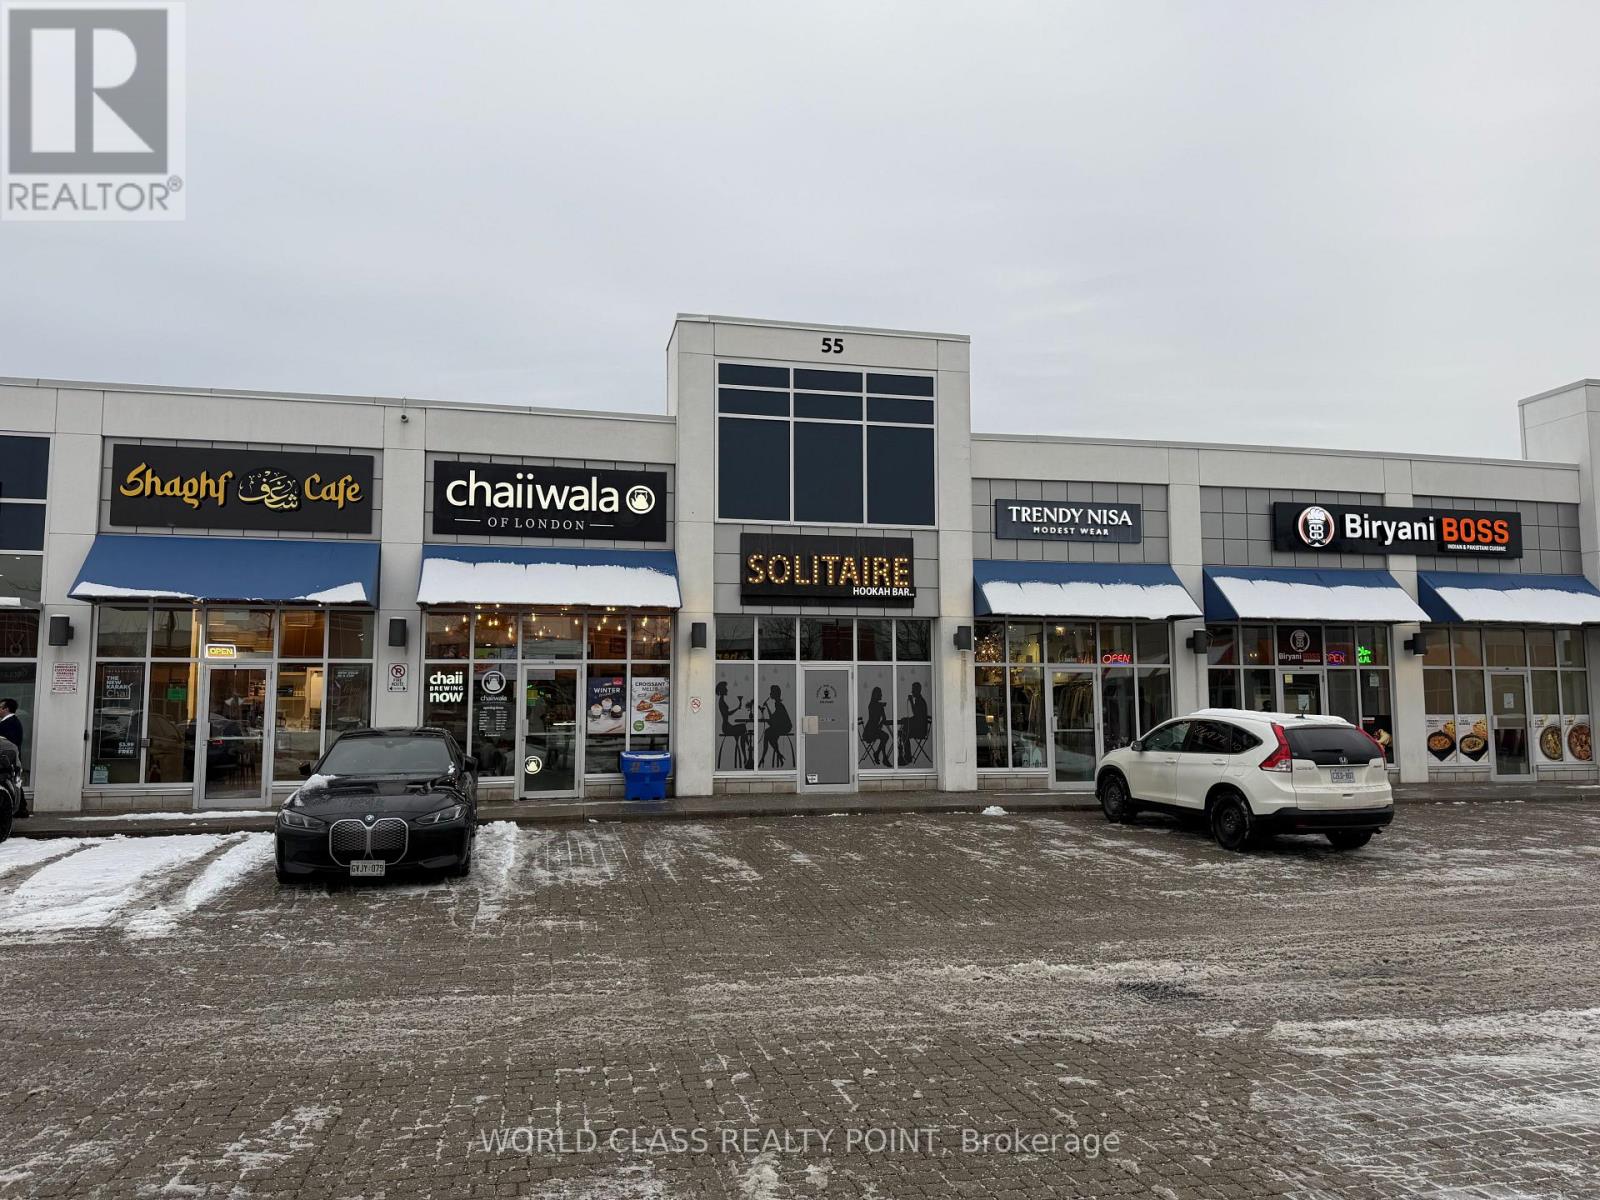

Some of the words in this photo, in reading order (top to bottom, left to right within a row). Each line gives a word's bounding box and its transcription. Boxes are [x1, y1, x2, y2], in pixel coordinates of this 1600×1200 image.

[821, 337, 844, 353] 55
[119, 462, 233, 509] Shaghf
[304, 473, 363, 509] Cafe
[446, 469, 619, 513] chaiiwala
[487, 516, 509, 528] OF
[514, 518, 585, 530] LONDON
[1007, 506, 1084, 524] TRENDY
[1087, 509, 1133, 526] NISA
[1033, 526, 1076, 535] MODEST
[1080, 527, 1109, 536] WEAR
[1345, 513, 1436, 546] Biryani
[1442, 517, 1510, 544] BOSS
[746, 553, 911, 587] SOLITAIRE
[853, 586, 891, 596] HOOKAH
[210, 647, 233, 656] OPEN
[1279, 652, 1302, 661] Biryani
[1327, 653, 1345, 663] PEN
[1102, 654, 1131, 664] OPEN
[429, 671, 463, 685] chaii
[429, 692, 463, 703] now
